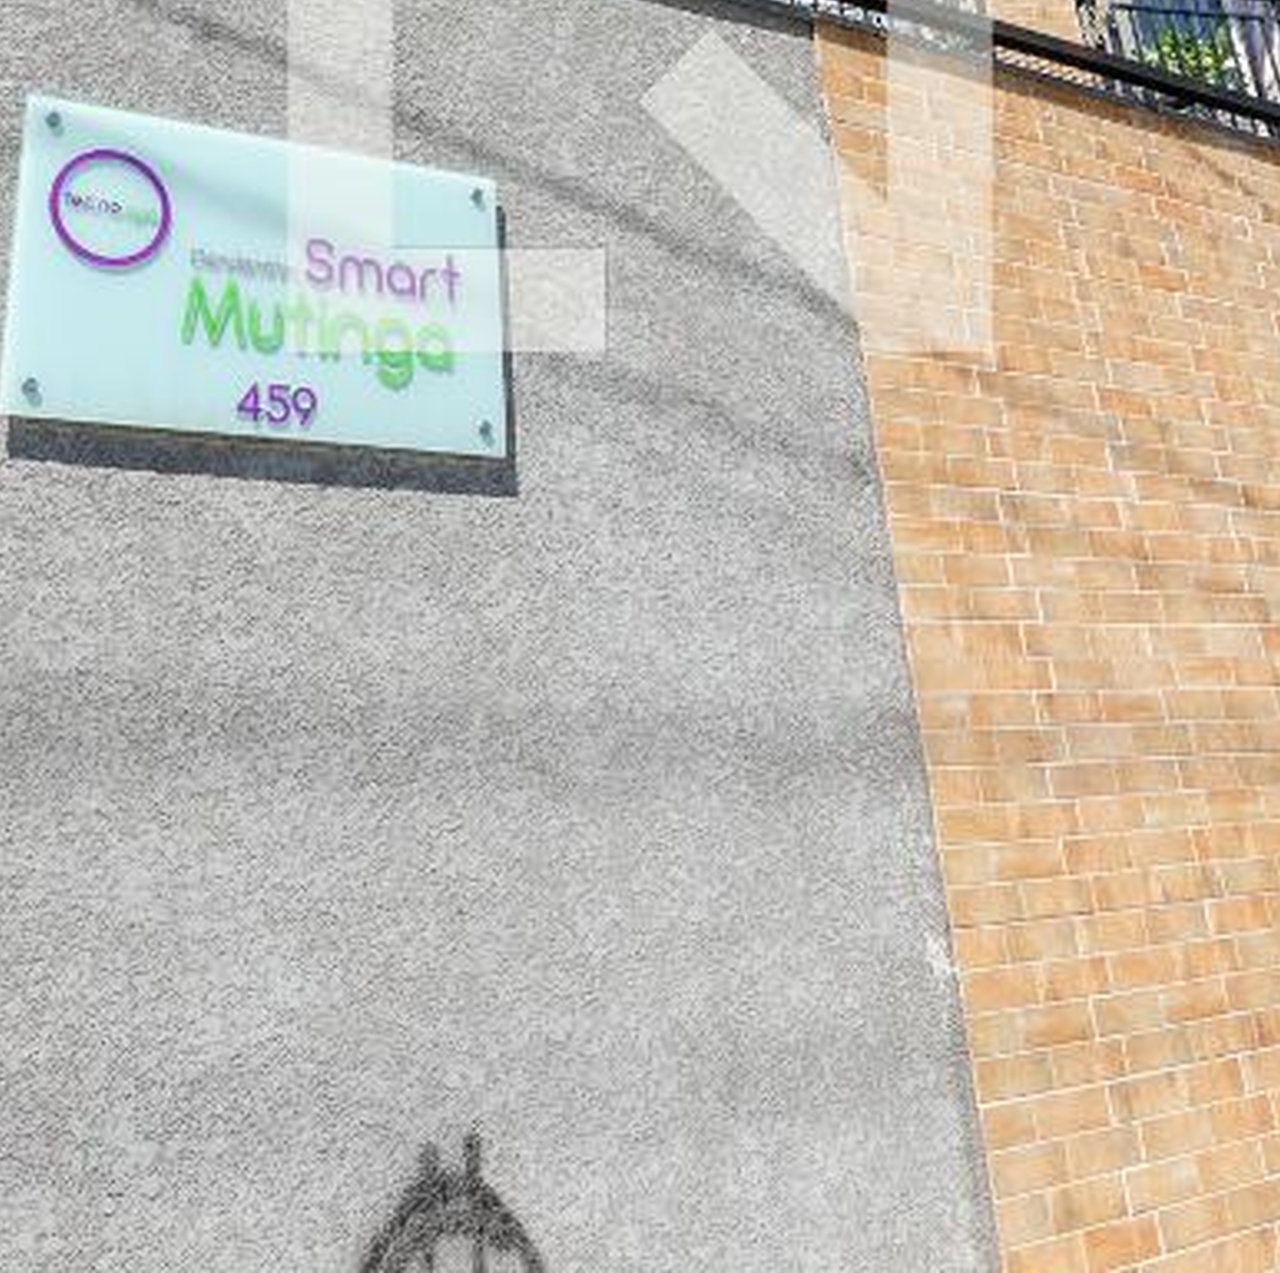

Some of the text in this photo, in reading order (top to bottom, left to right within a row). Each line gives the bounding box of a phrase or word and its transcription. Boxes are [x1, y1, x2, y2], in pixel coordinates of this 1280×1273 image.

[304, 238, 461, 306] Smart
[181, 277, 456, 392] Mutinga
[235, 381, 318, 426] 459
